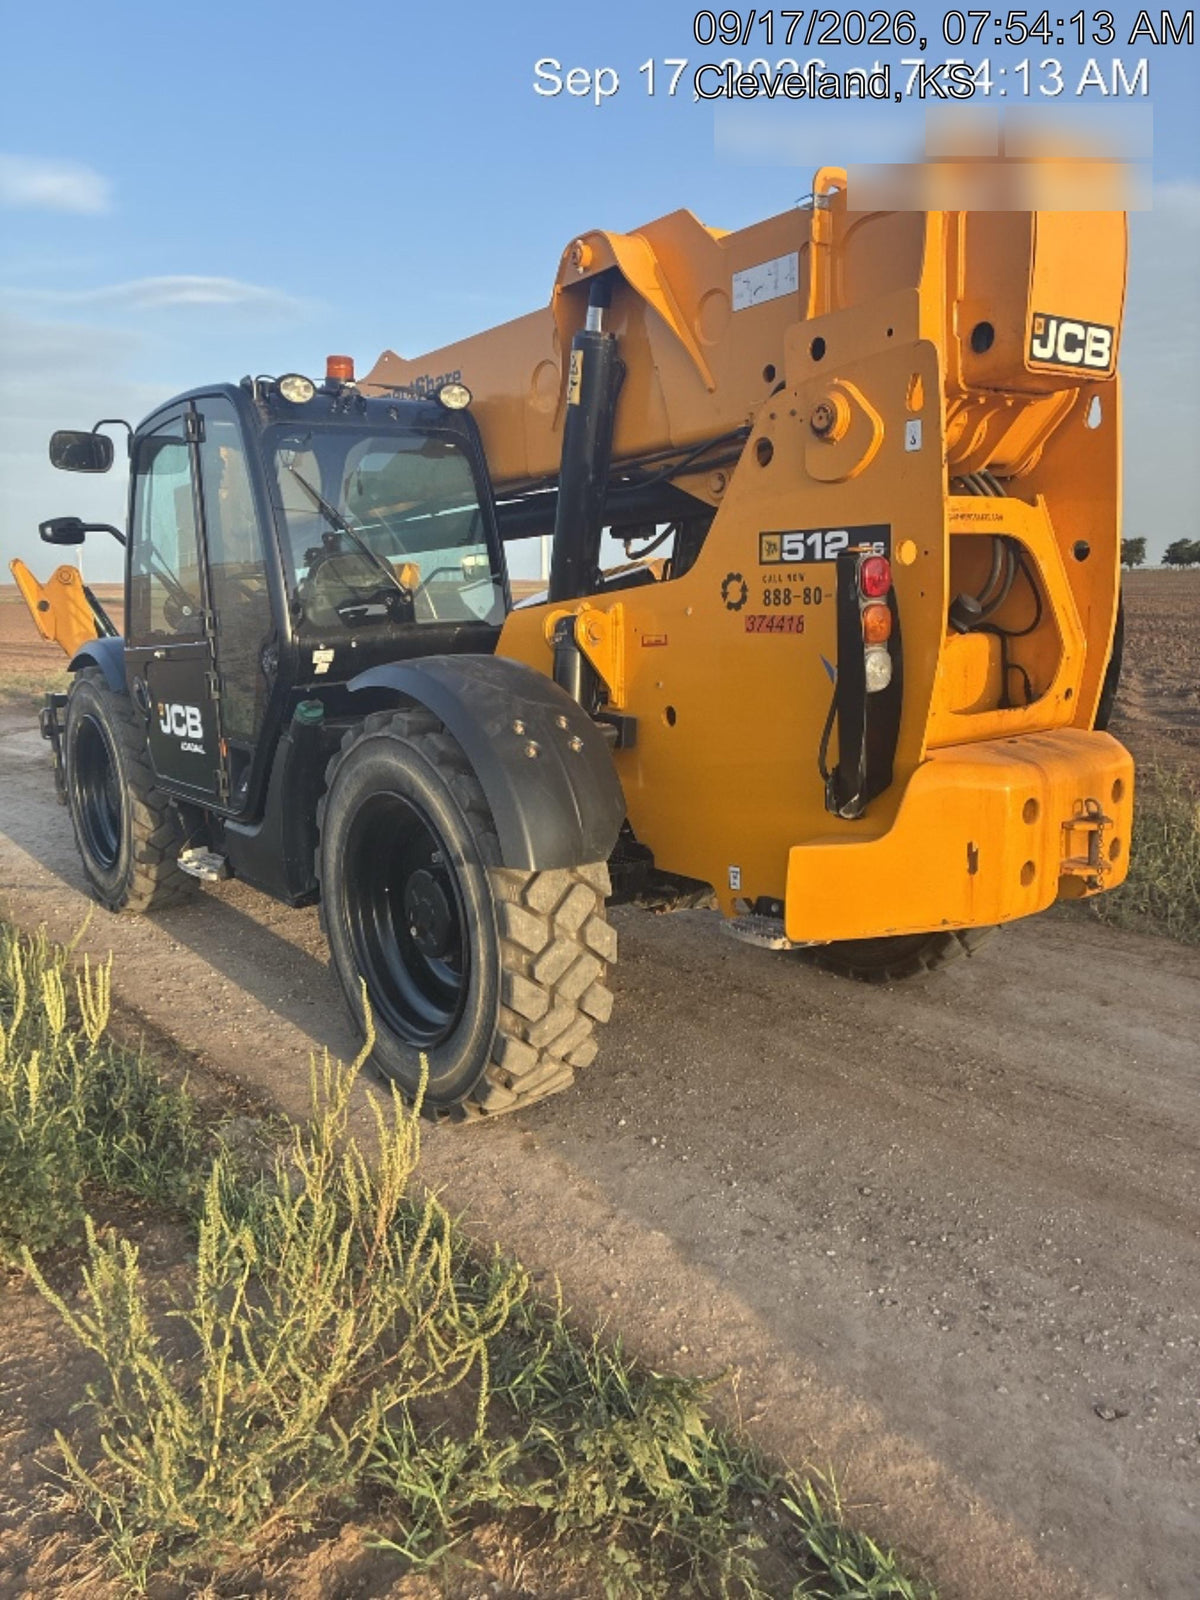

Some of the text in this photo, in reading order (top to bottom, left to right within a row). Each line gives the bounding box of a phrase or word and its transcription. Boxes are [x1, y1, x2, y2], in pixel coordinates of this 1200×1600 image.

[1032, 319, 1112, 368] JCB
[781, 530, 849, 561] 512
[762, 573, 783, 584] CALL
[745, 614, 805, 634] 374416
[159, 703, 204, 739] JCB
